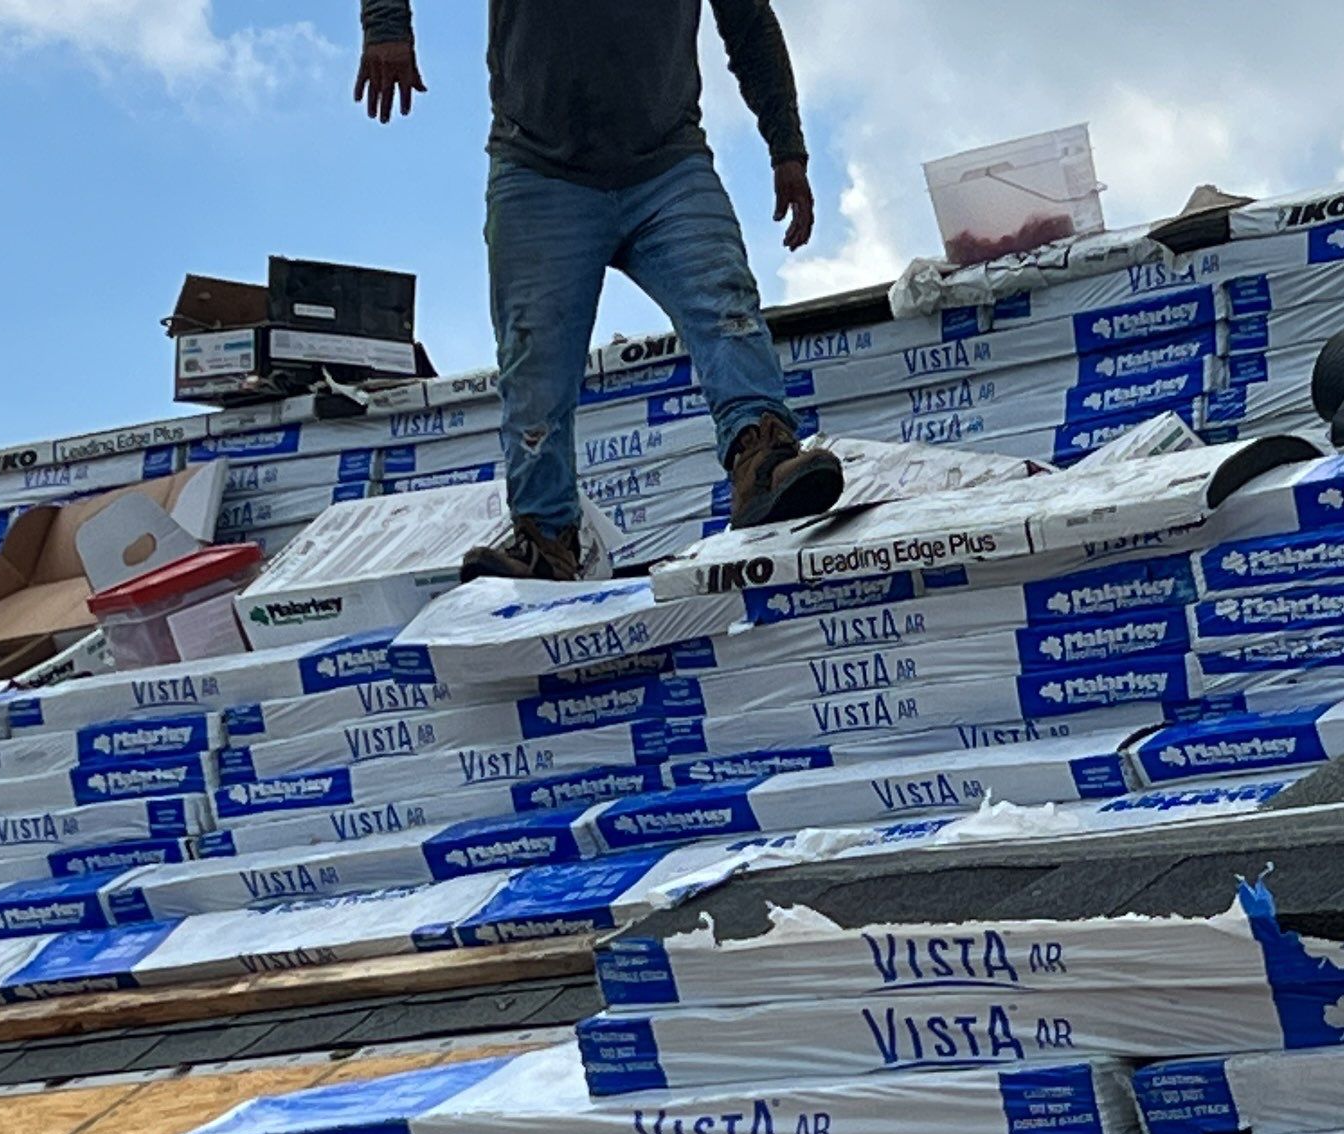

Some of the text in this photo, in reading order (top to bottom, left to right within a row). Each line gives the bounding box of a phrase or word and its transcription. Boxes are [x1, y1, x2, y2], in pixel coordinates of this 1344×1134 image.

[788, 330, 851, 362] VISTA
[905, 340, 970, 374] VISTA
[910, 377, 975, 412] VISTA
[391, 408, 445, 438] VISTA
[901, 413, 963, 445] VISTA
[60, 438, 115, 462] Leading
[116, 431, 151, 449] Edge
[154, 426, 185, 443] Plus
[585, 430, 643, 464] VISTA
[810, 545, 892, 579] Leading
[894, 537, 946, 566] Edge
[949, 531, 997, 557] Plus
[1071, 576, 1176, 607] Malarkey
[266, 597, 344, 622] Malarkey
[540, 622, 650, 667] VISTA AR
[819, 608, 927, 648] VISTA AR
[1063, 620, 1168, 651] Malarkey
[809, 652, 917, 694] VISTA AR
[1064, 671, 1169, 700] Malarkey
[132, 676, 198, 707] VISTA
[357, 683, 429, 712] VISTA
[812, 692, 920, 735] VISTA AR
[346, 721, 416, 757] VISTA
[1184, 737, 1298, 769] Malarkey
[459, 745, 554, 783] VISTA AR
[872, 773, 984, 810] VISTA AR
[330, 803, 405, 839] VISTA
[240, 864, 340, 898] VISTA AR
[862, 929, 1067, 984] VISTA AR
[862, 1004, 1076, 1066] VISTA AR
